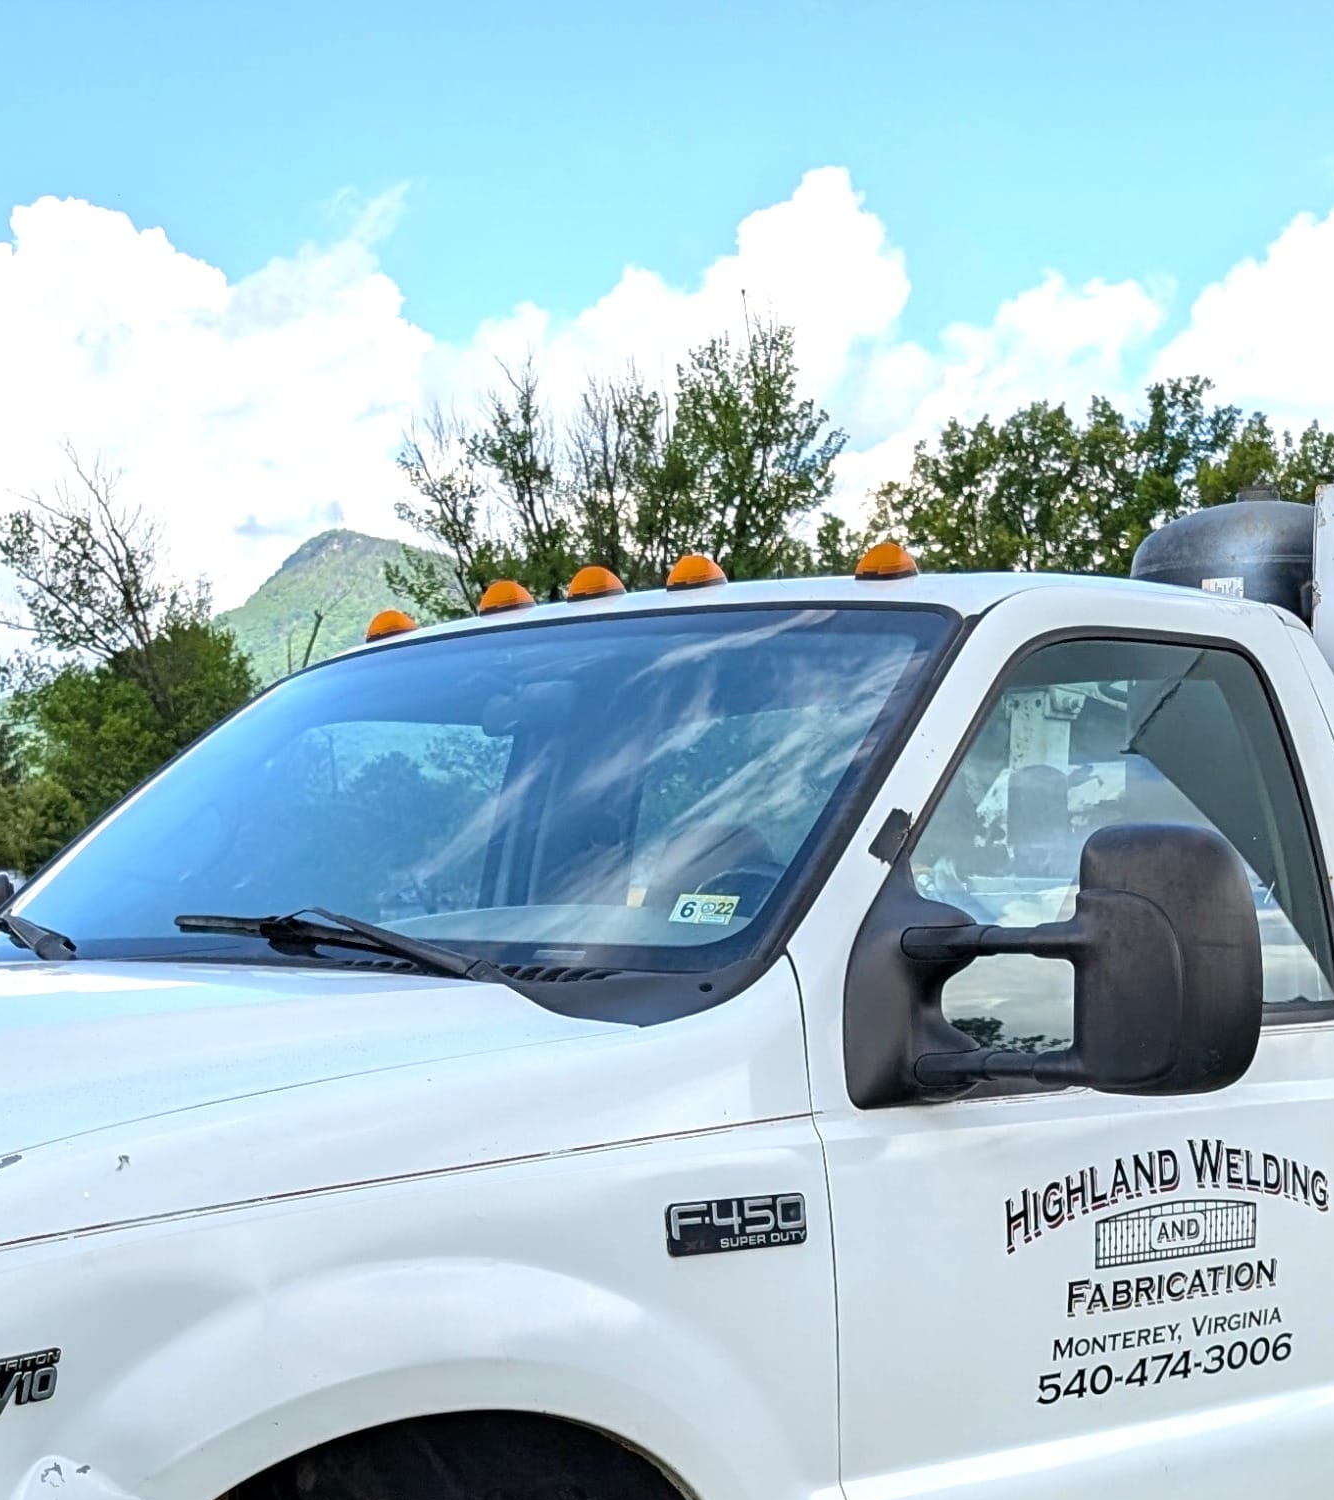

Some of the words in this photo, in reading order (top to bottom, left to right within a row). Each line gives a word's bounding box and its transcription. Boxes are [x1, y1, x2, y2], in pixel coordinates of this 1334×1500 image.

[680, 901, 697, 918] 6
[714, 902, 735, 915] 22
[1004, 1147, 1181, 1255] HIGHLAND
[1186, 1138, 1330, 1212] WELDING
[720, 1234, 766, 1248] SUPER
[770, 1230, 806, 1243] DUTY
[1156, 1217, 1201, 1243] AND
[1066, 1257, 1278, 1318] FABRICATION
[1052, 1322, 1184, 1361] MONTEREY,
[1192, 1306, 1282, 1337] VIRGINIA
[1036, 1332, 1294, 1405] 540-474-3006
